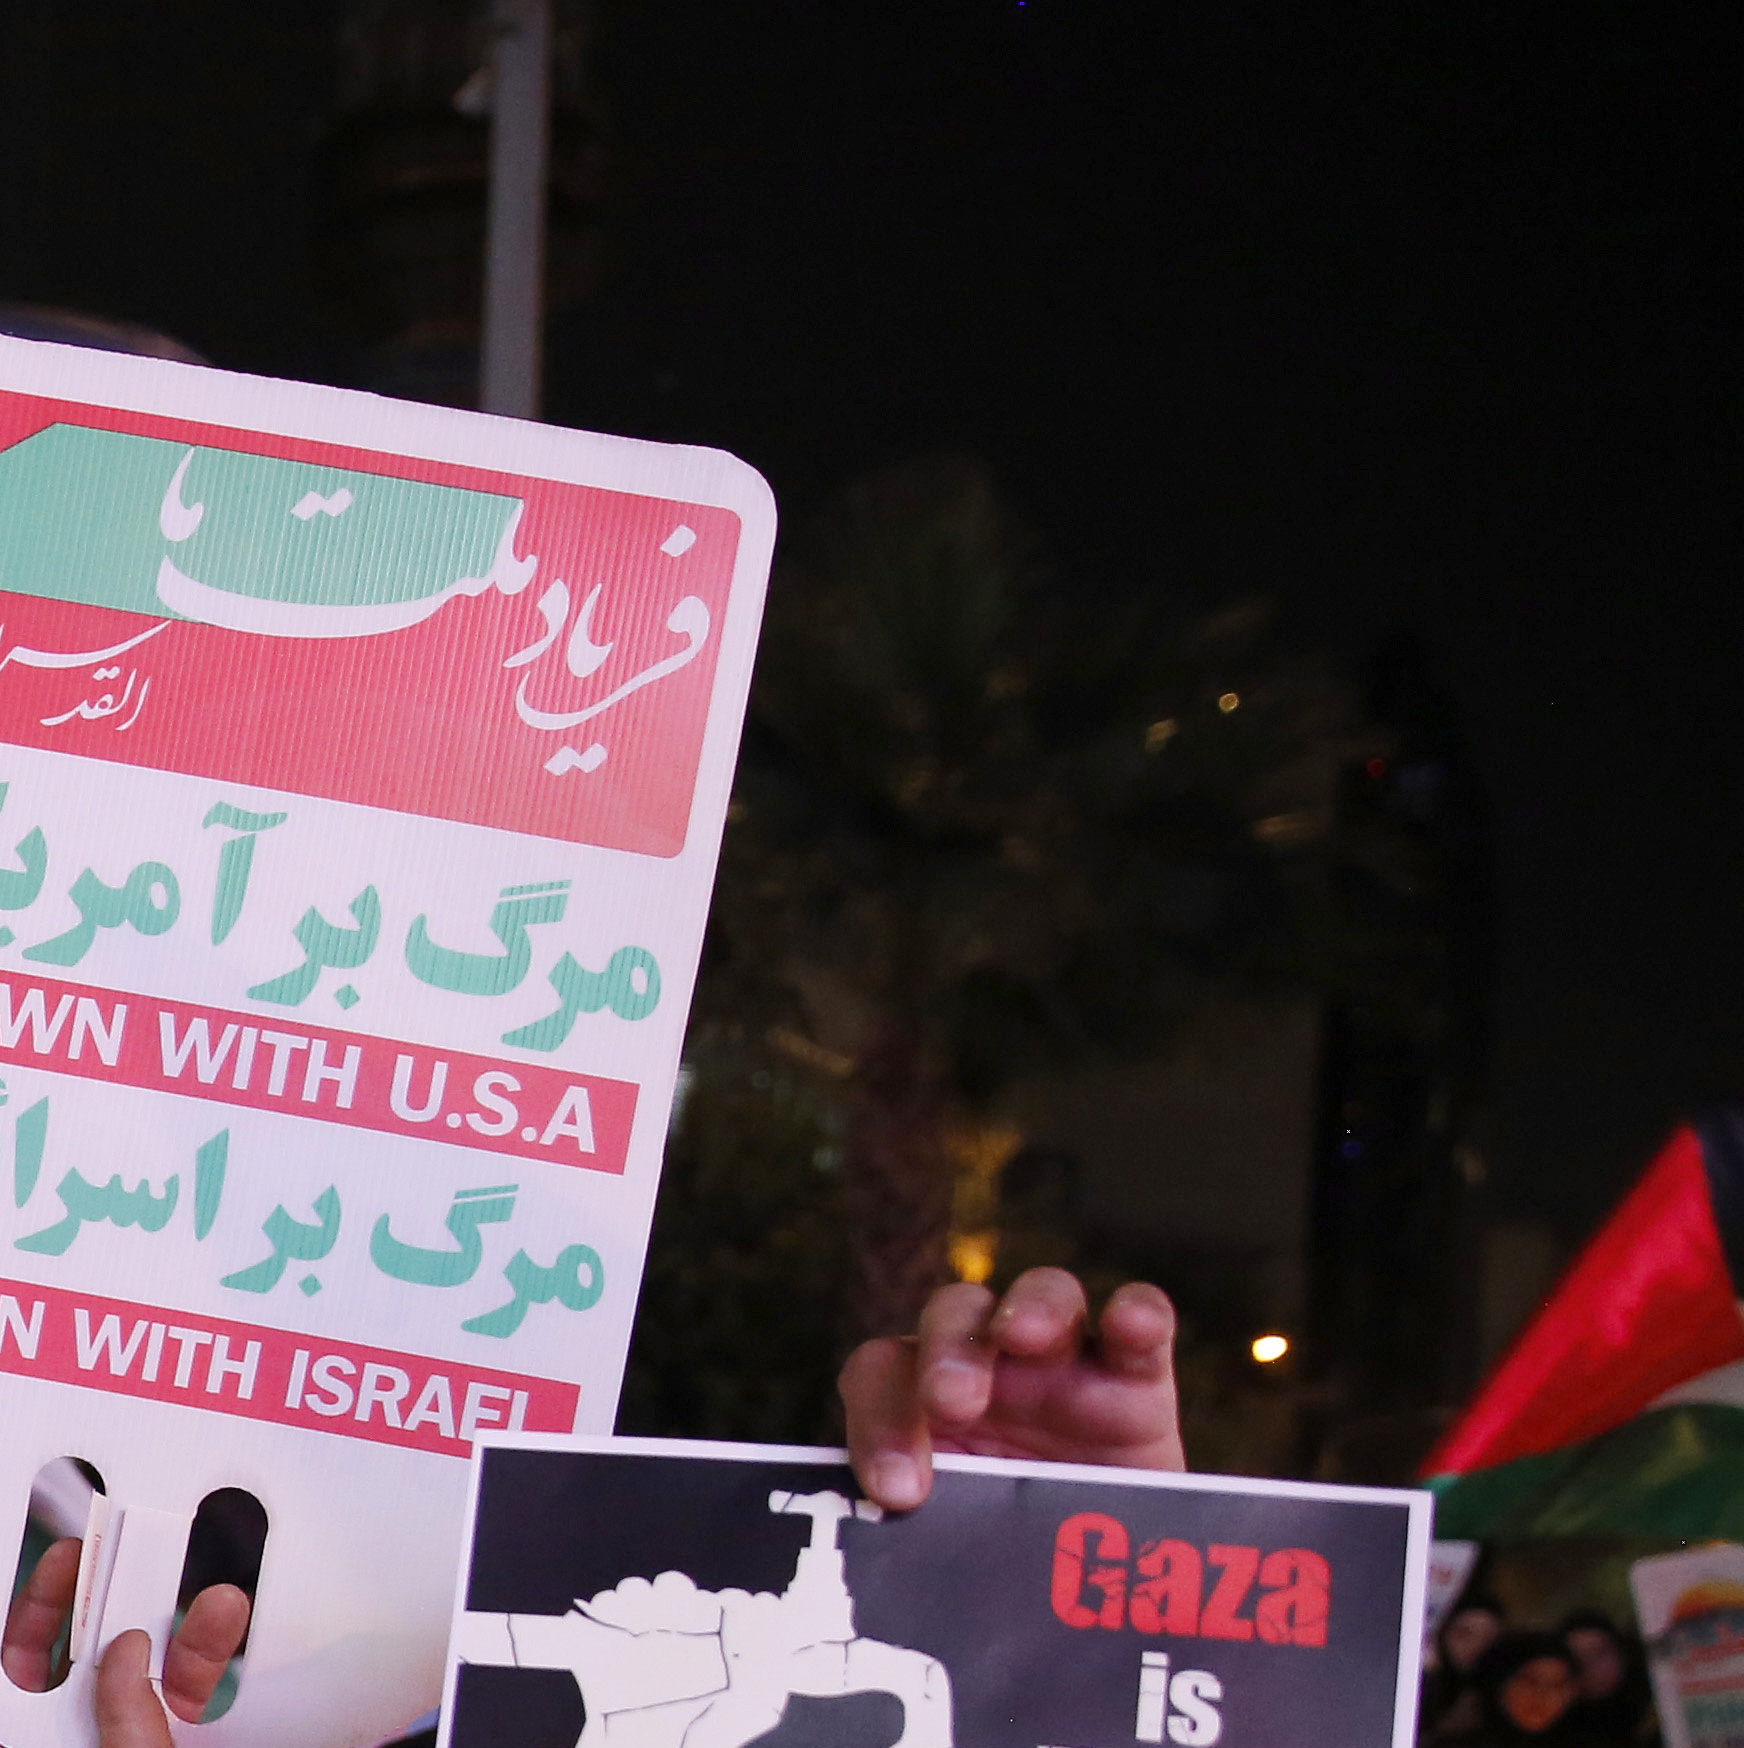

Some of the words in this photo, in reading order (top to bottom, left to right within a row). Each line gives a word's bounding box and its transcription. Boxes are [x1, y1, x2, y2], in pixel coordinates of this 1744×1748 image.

[159, 446, 205, 541] ما
[157, 487, 539, 639] ملت
[502, 524, 711, 776] فریاد
[246, 882, 381, 1010] بر
[405, 879, 662, 1052] مرگ
[160, 1013, 358, 1111] WITH
[392, 1051, 597, 1154] U.S.A
[220, 1183, 340, 1296] بر
[369, 1183, 606, 1339] مرگ
[73, 1308, 259, 1399] WITH
[1051, 1512, 1332, 1648] Gaza
[1135, 1652, 1223, 1748] is
